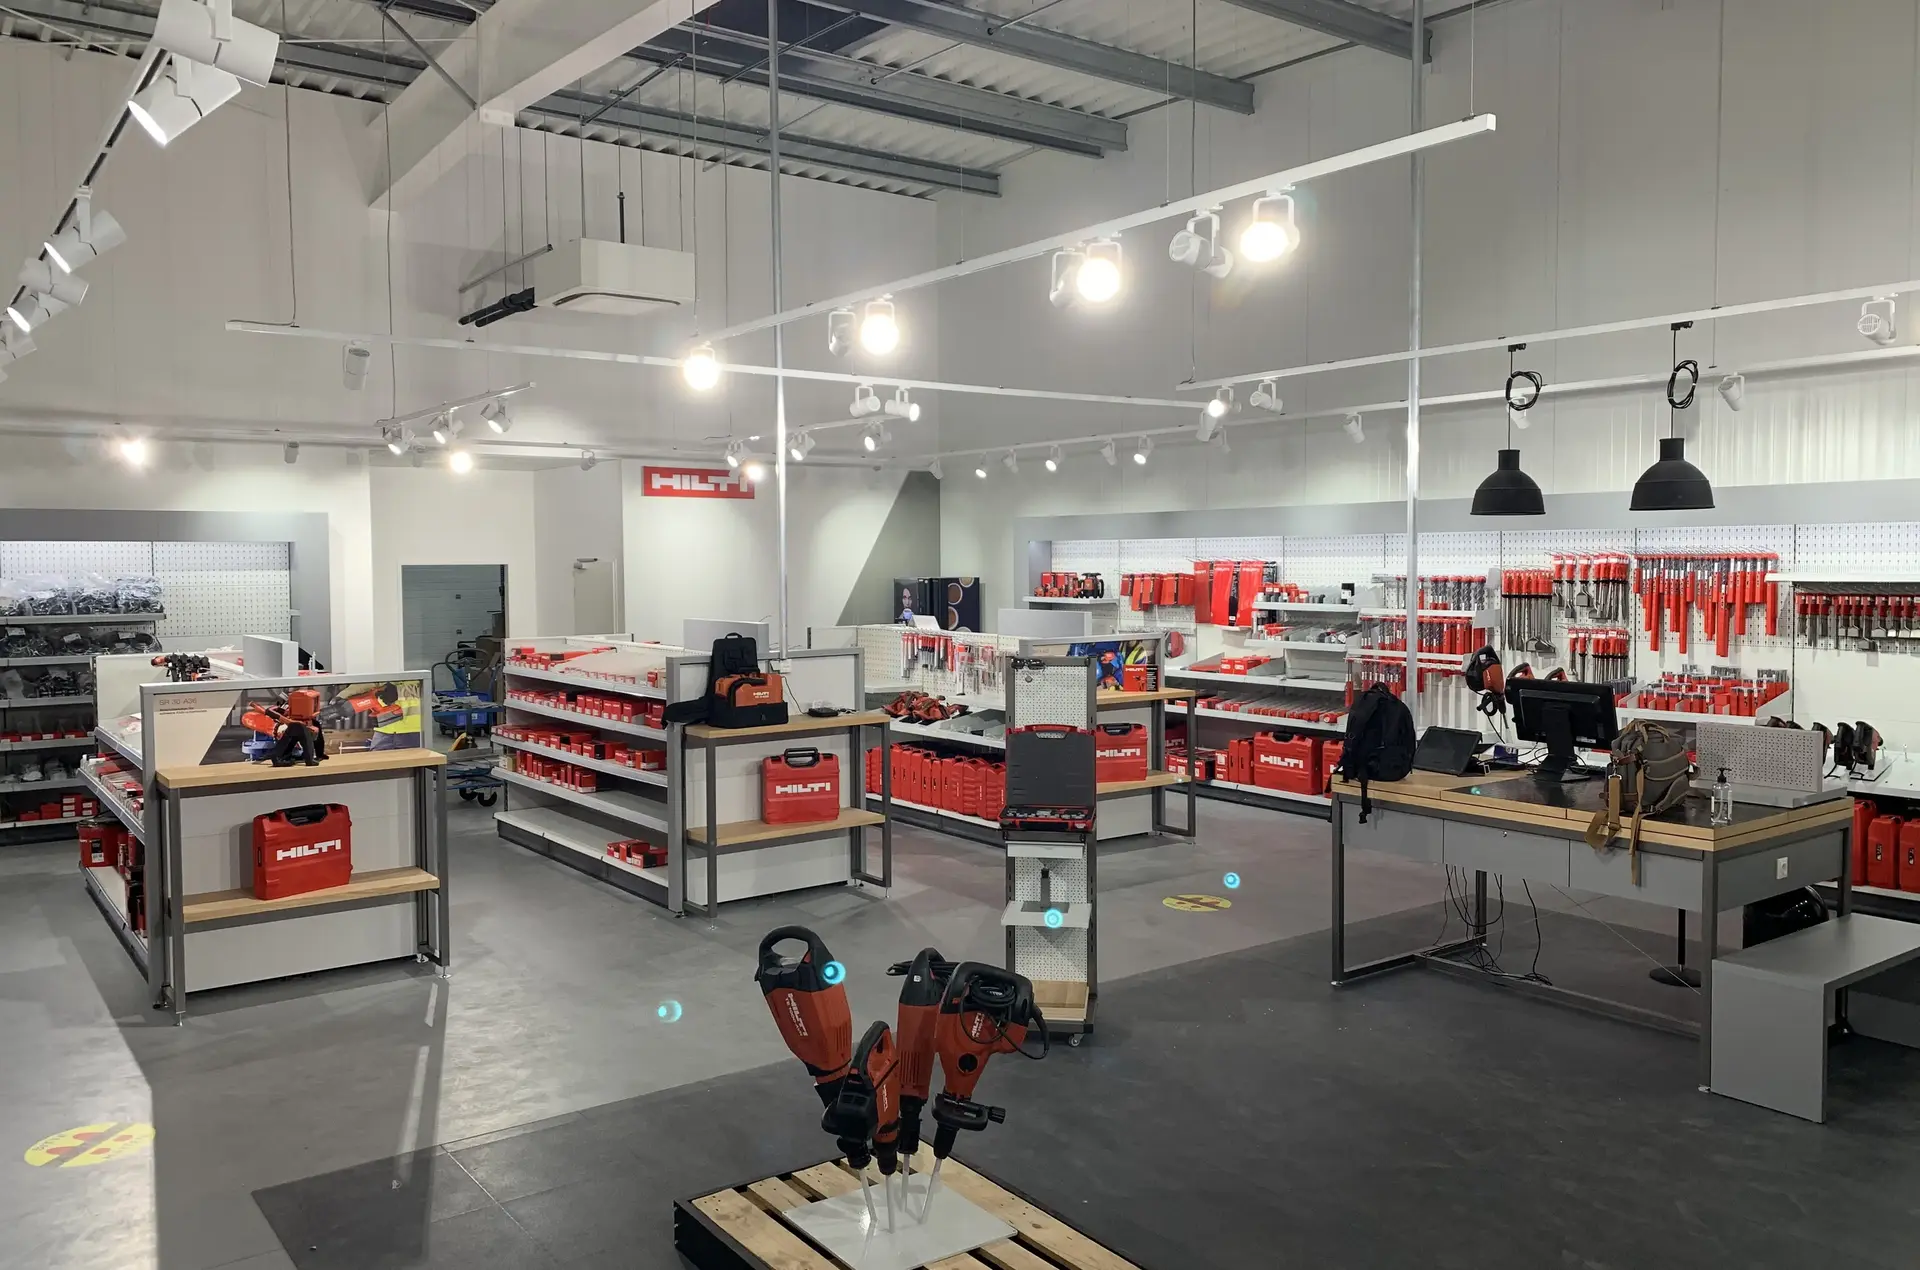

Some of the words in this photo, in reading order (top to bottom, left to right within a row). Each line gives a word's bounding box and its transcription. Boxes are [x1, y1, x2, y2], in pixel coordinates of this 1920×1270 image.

[652, 473, 748, 492] HILTI
[1096, 748, 1141, 758] HILTI
[1260, 754, 1304, 769] HILTI
[776, 782, 831, 794] HILTI
[277, 839, 341, 861] HILTI
[787, 992, 808, 1037] HILTI
